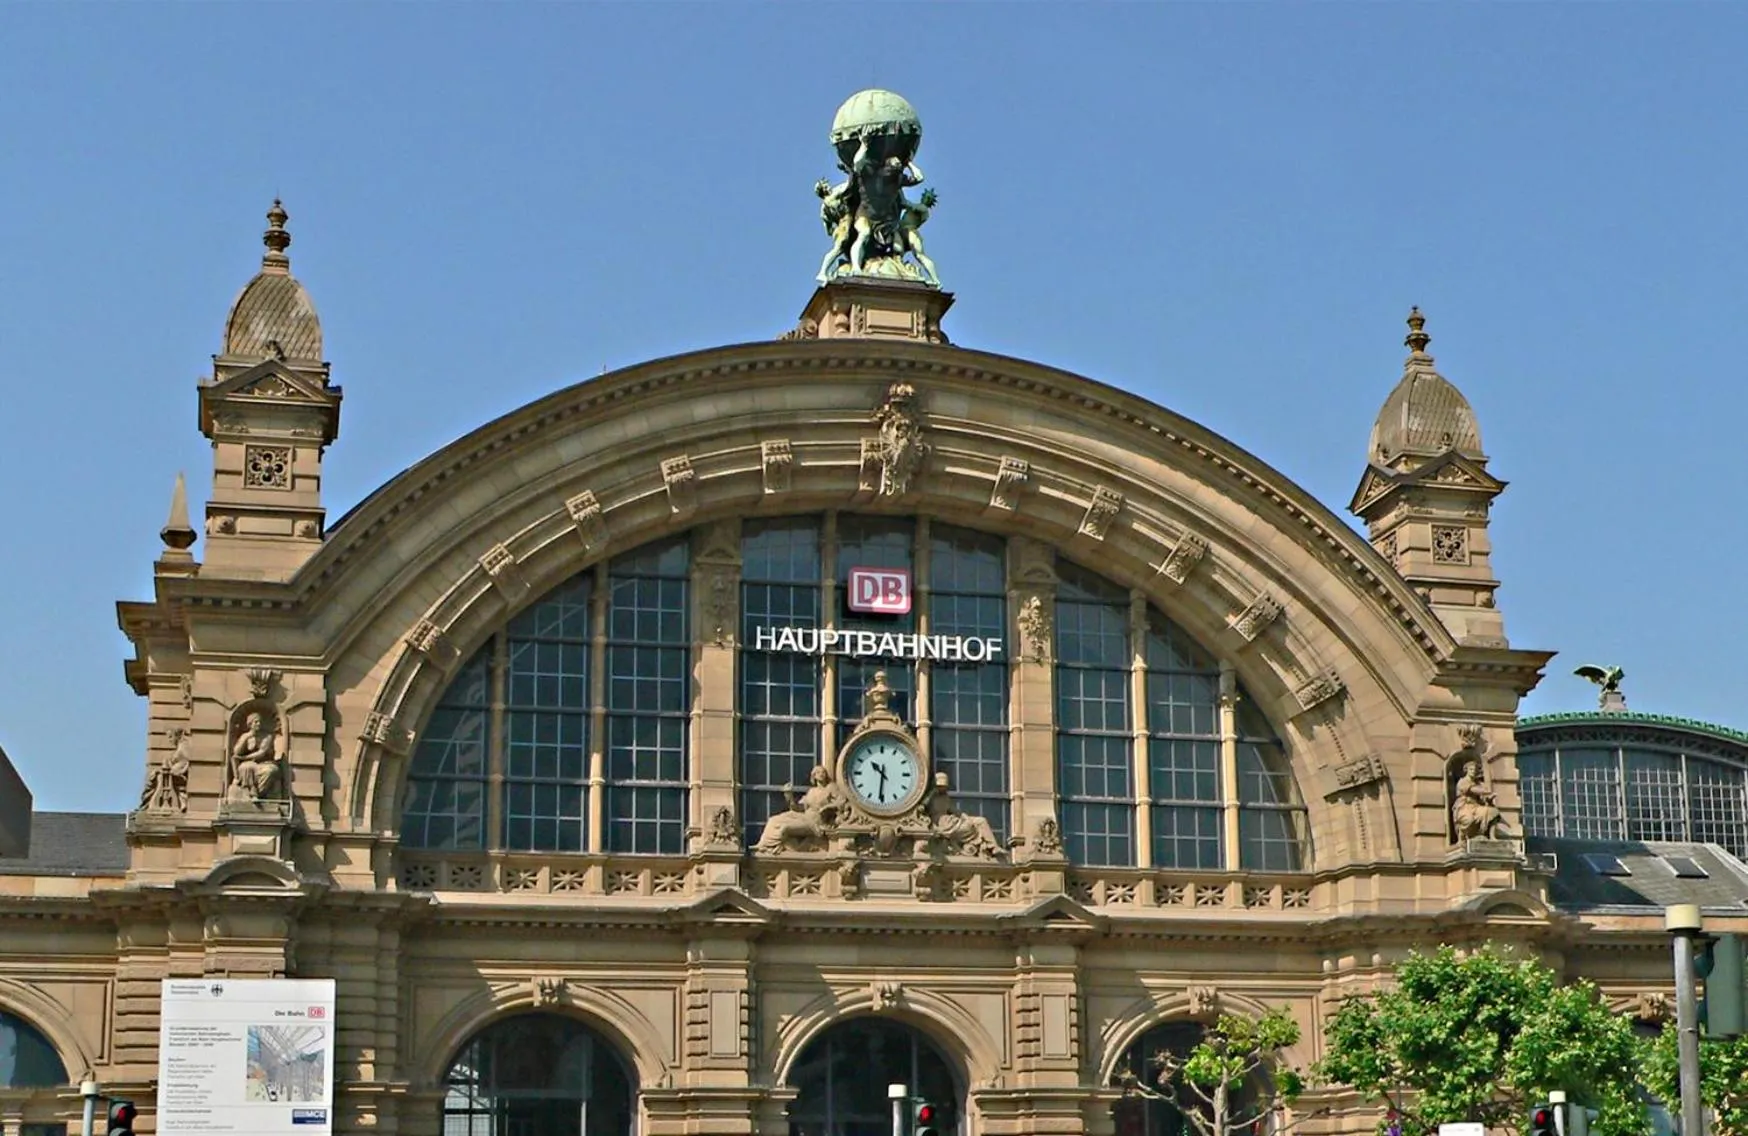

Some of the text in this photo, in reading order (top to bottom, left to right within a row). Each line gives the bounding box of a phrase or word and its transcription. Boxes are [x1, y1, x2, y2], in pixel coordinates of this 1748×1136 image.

[855, 573, 905, 607] DB
[755, 626, 1003, 662] HAUPTBAHNHOF
[310, 1007, 324, 1017] DB
